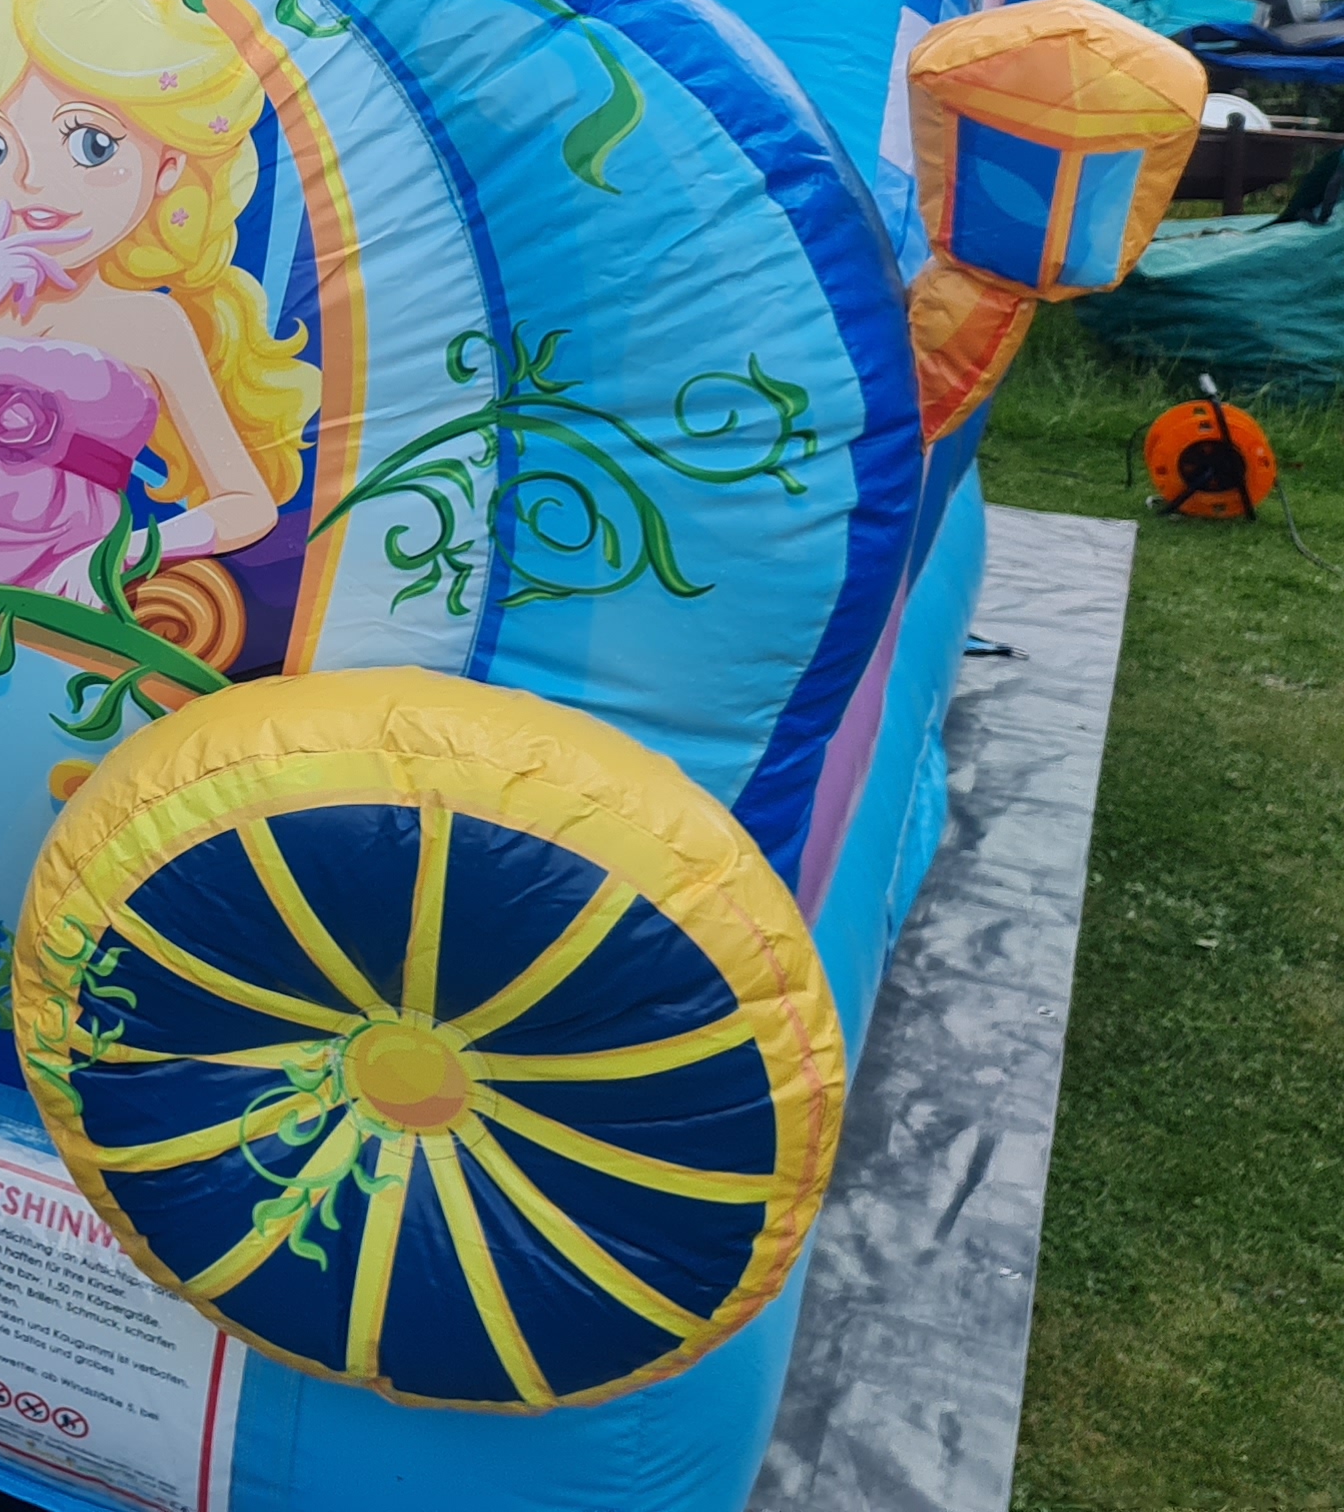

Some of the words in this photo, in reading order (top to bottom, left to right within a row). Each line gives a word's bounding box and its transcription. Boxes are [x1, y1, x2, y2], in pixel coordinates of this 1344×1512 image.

[4, 1246, 43, 1268] haften
[45, 1260, 62, 1274] für
[72, 1289, 85, 1300] m
[27, 1321, 51, 1336] und
[116, 1352, 130, 1365] ist
[124, 1325, 177, 1352] scharfen
[49, 1345, 73, 1359] und
[74, 1355, 115, 1376] grobes
[40, 1371, 58, 1383] ab
[139, 1407, 160, 1421] bei
